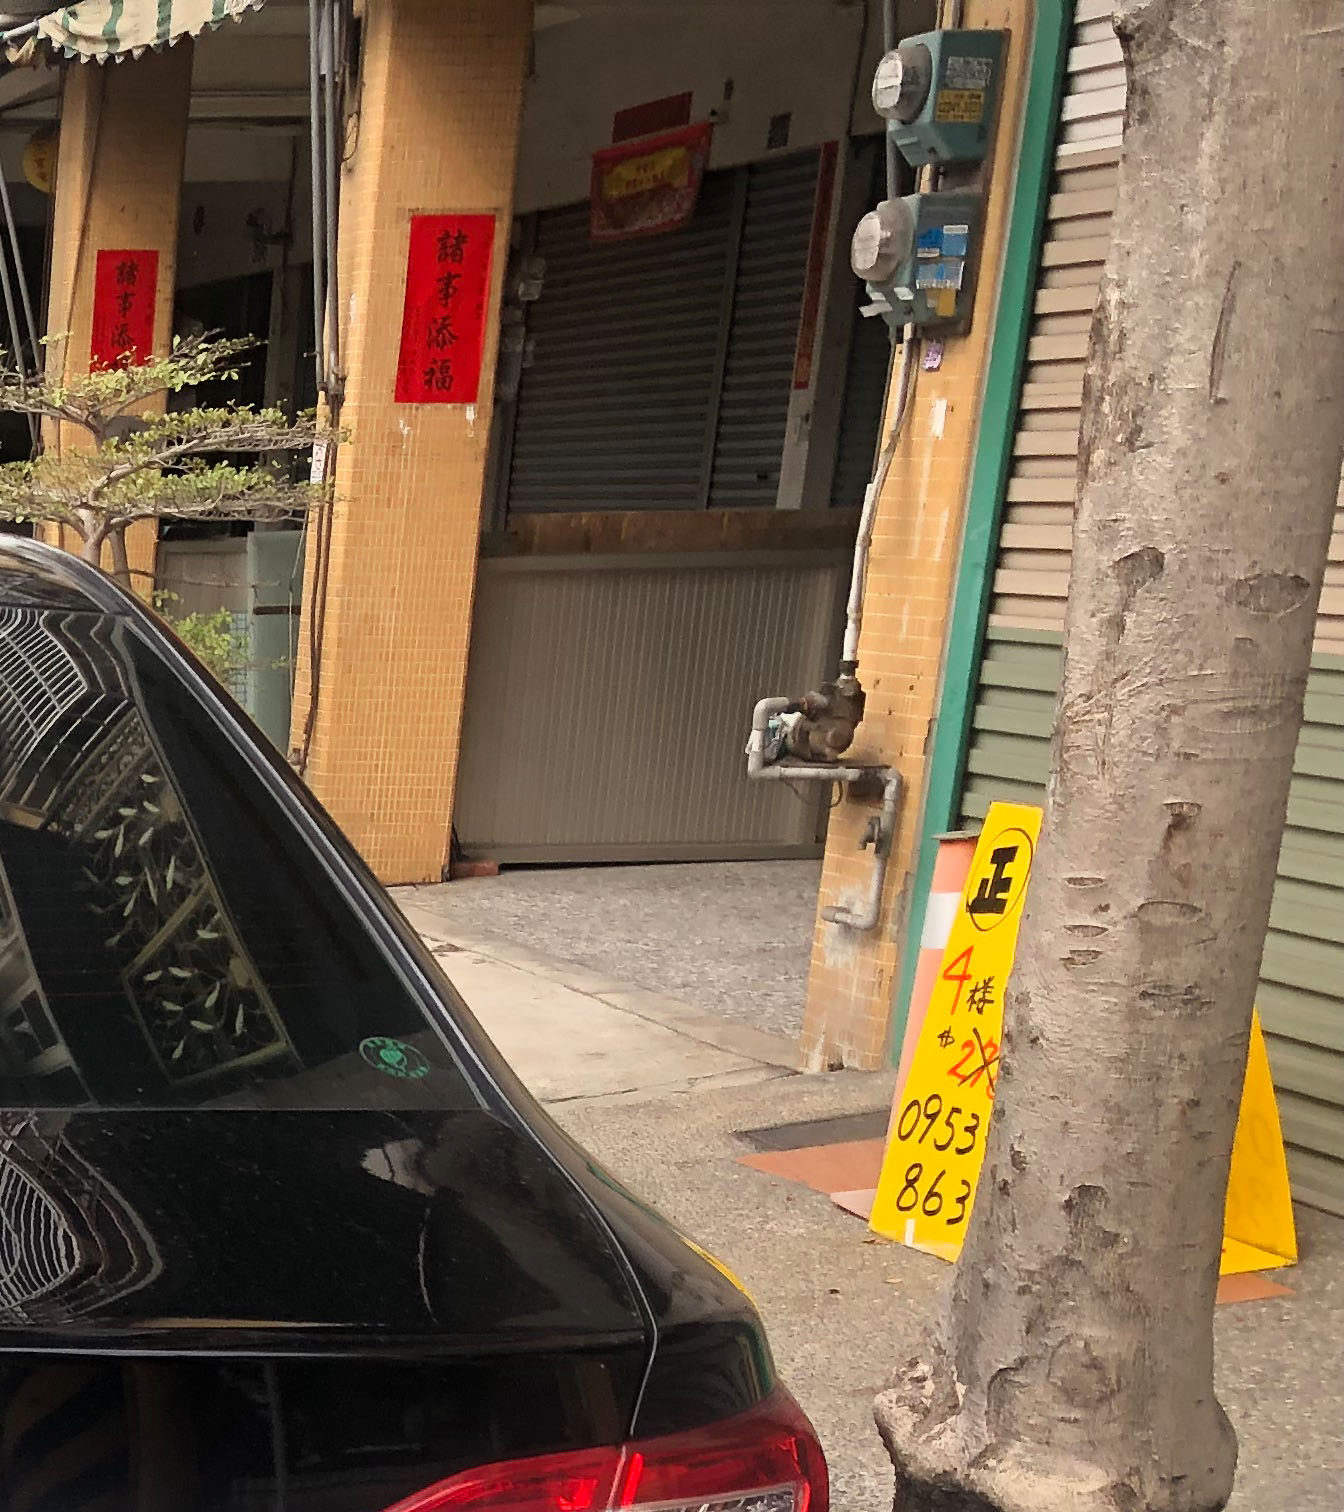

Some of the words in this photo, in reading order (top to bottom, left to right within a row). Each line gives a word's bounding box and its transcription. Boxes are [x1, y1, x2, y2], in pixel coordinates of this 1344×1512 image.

[423, 228, 469, 392] 諸事添福
[968, 845, 1020, 915] 正
[897, 1093, 980, 1155] 0953
[896, 1162, 971, 1225] 863
